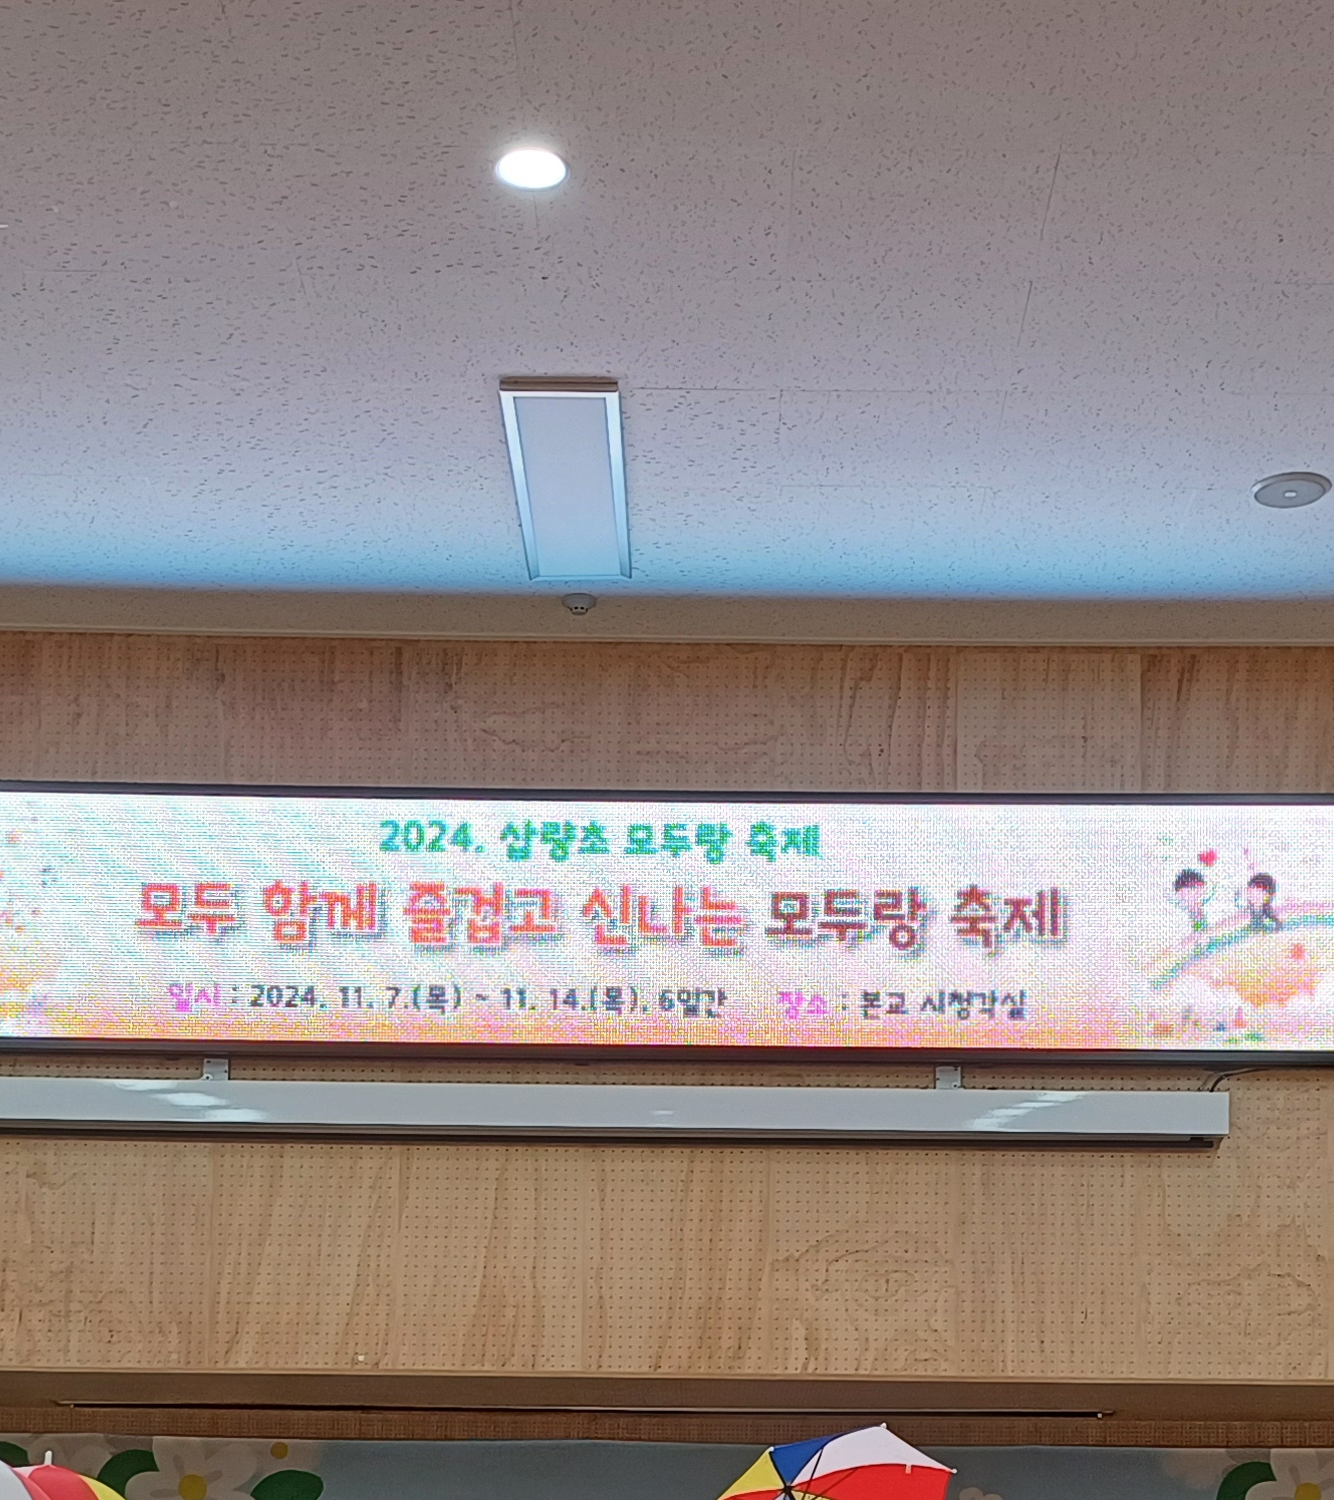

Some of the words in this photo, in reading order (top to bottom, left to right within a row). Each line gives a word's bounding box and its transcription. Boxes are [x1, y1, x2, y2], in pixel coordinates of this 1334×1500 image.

[379, 819, 484, 853] 2024.
[624, 821, 734, 865] 모두랑
[745, 820, 821, 863] 축제
[135, 881, 237, 937] 모두
[265, 879, 378, 943] 함께
[403, 881, 560, 945] 즐겁고
[582, 883, 747, 947] 신나는
[766, 885, 927, 951] 모두랑
[951, 883, 1061, 950] 축제
[777, 989, 829, 1020] 장소
[860, 989, 911, 1020] 본교
[920, 989, 1029, 1021] 시청각실
